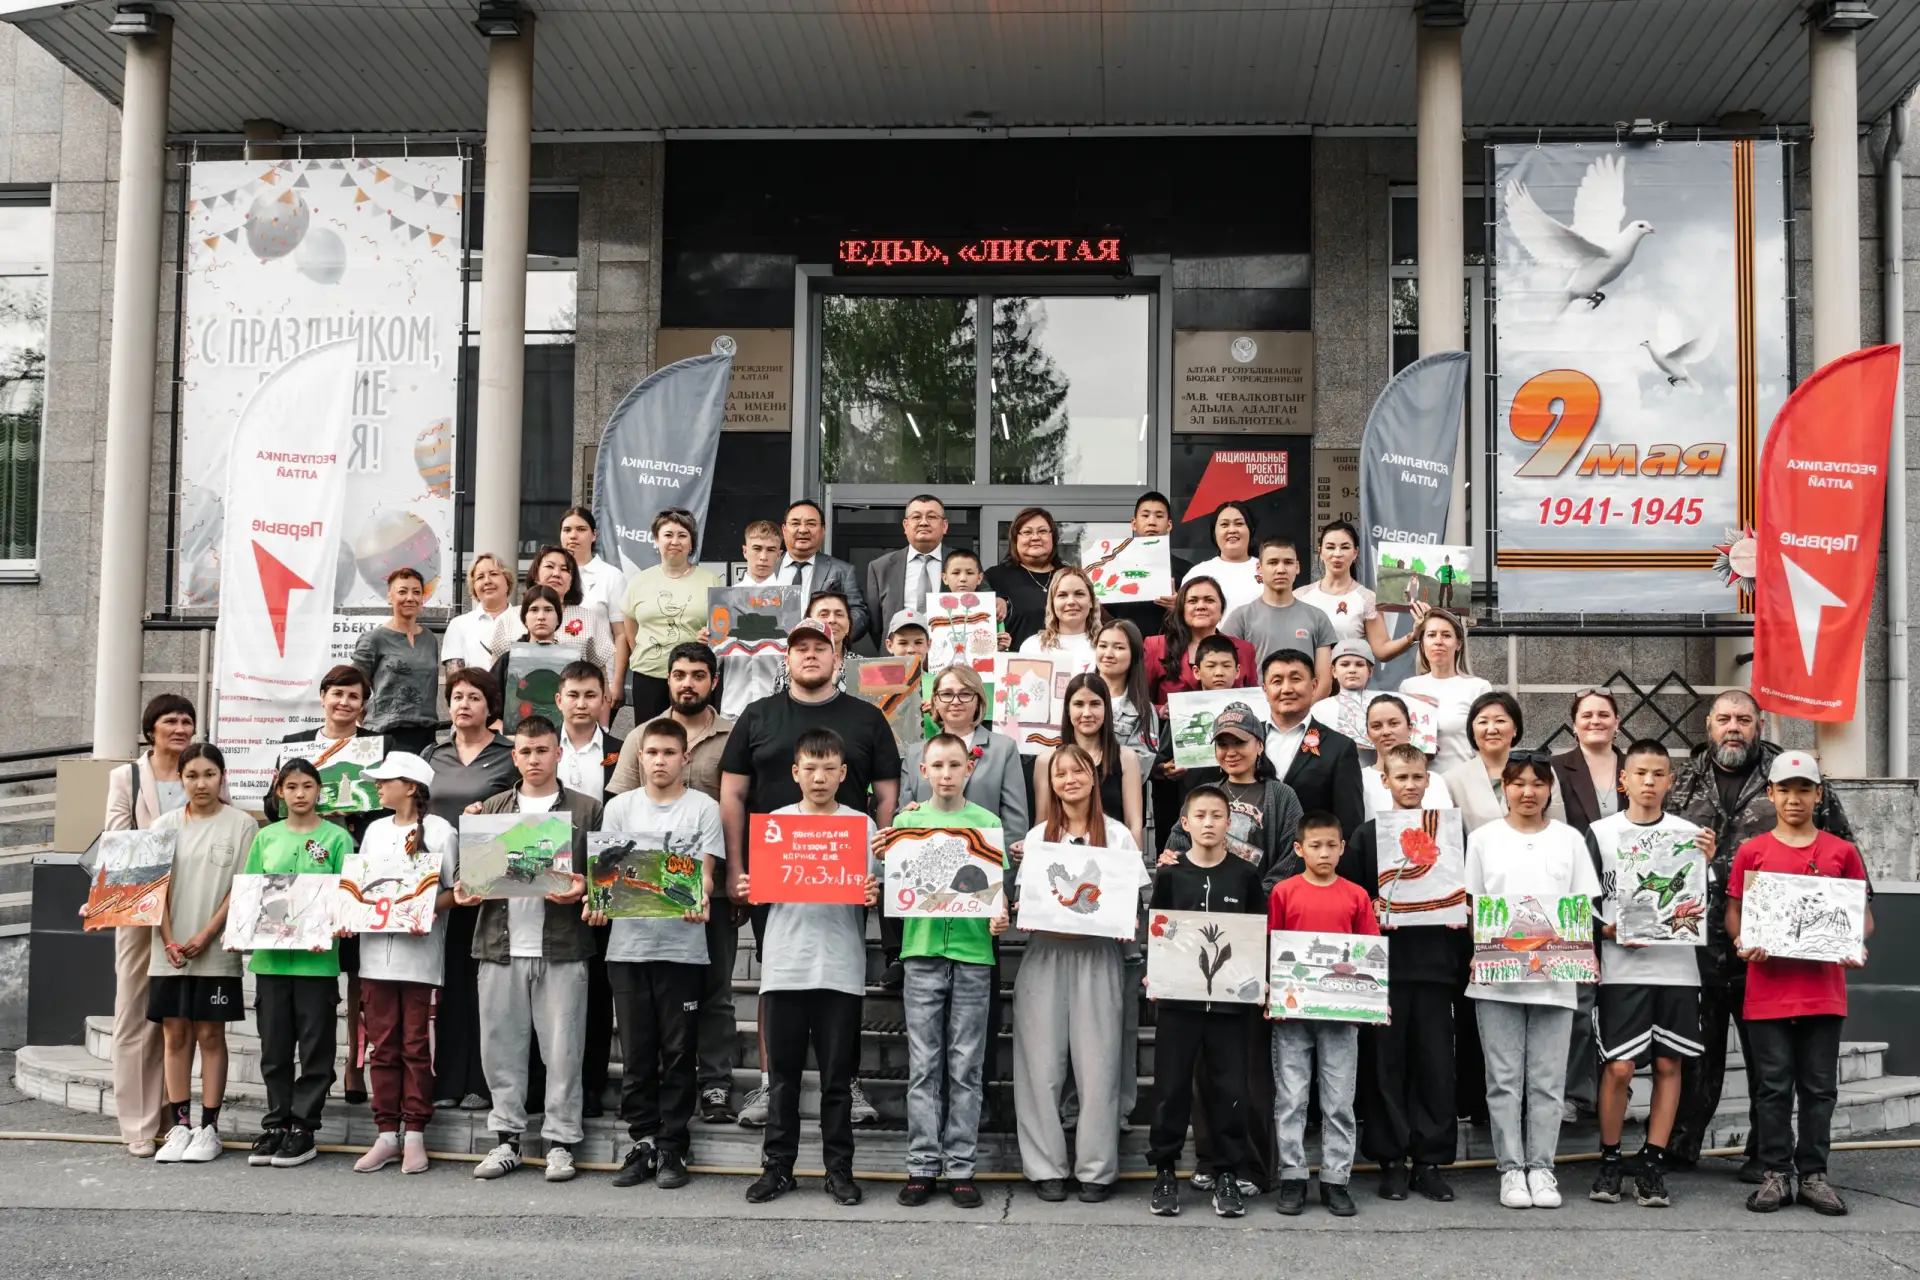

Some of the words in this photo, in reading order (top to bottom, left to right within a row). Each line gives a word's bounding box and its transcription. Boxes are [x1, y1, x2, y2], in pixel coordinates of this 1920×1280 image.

[957, 239, 1120, 262] «ЛИСТАЯ
[201, 318, 217, 365] С
[1186, 366, 1217, 374] АЛТАЙ
[740, 372, 769, 380] АЛТАЙ
[1186, 375, 1226, 383] БЮДЖЕТ
[728, 390, 774, 399] АЛЬНАЯ
[744, 402, 787, 411] ИМЕНИ
[1190, 404, 1234, 414] АДЫЛА
[1241, 405, 1298, 414] АДАЛГАН
[723, 414, 775, 423] АЛКОВА»
[1189, 416, 1205, 425] ЭЛ
[1509, 369, 1601, 478] 9
[1575, 443, 1728, 478] мая
[1215, 452, 1287, 463] НАЦИОНАЛЬНЫЕ
[1245, 463, 1287, 474] ПРОЕКТЫ
[1253, 474, 1287, 485] РОССИИ
[1341, 487, 1360, 498] 9-2
[1538, 496, 1705, 526] 1941-1945
[1101, 540, 1110, 554] 9
[332, 622, 382, 633] БЪЕКТ
[711, 607, 729, 645] 9
[896, 888, 916, 912] 9
[925, 900, 982, 914] мая
[369, 897, 391, 930] 9
[210, 986, 229, 1005] alo
